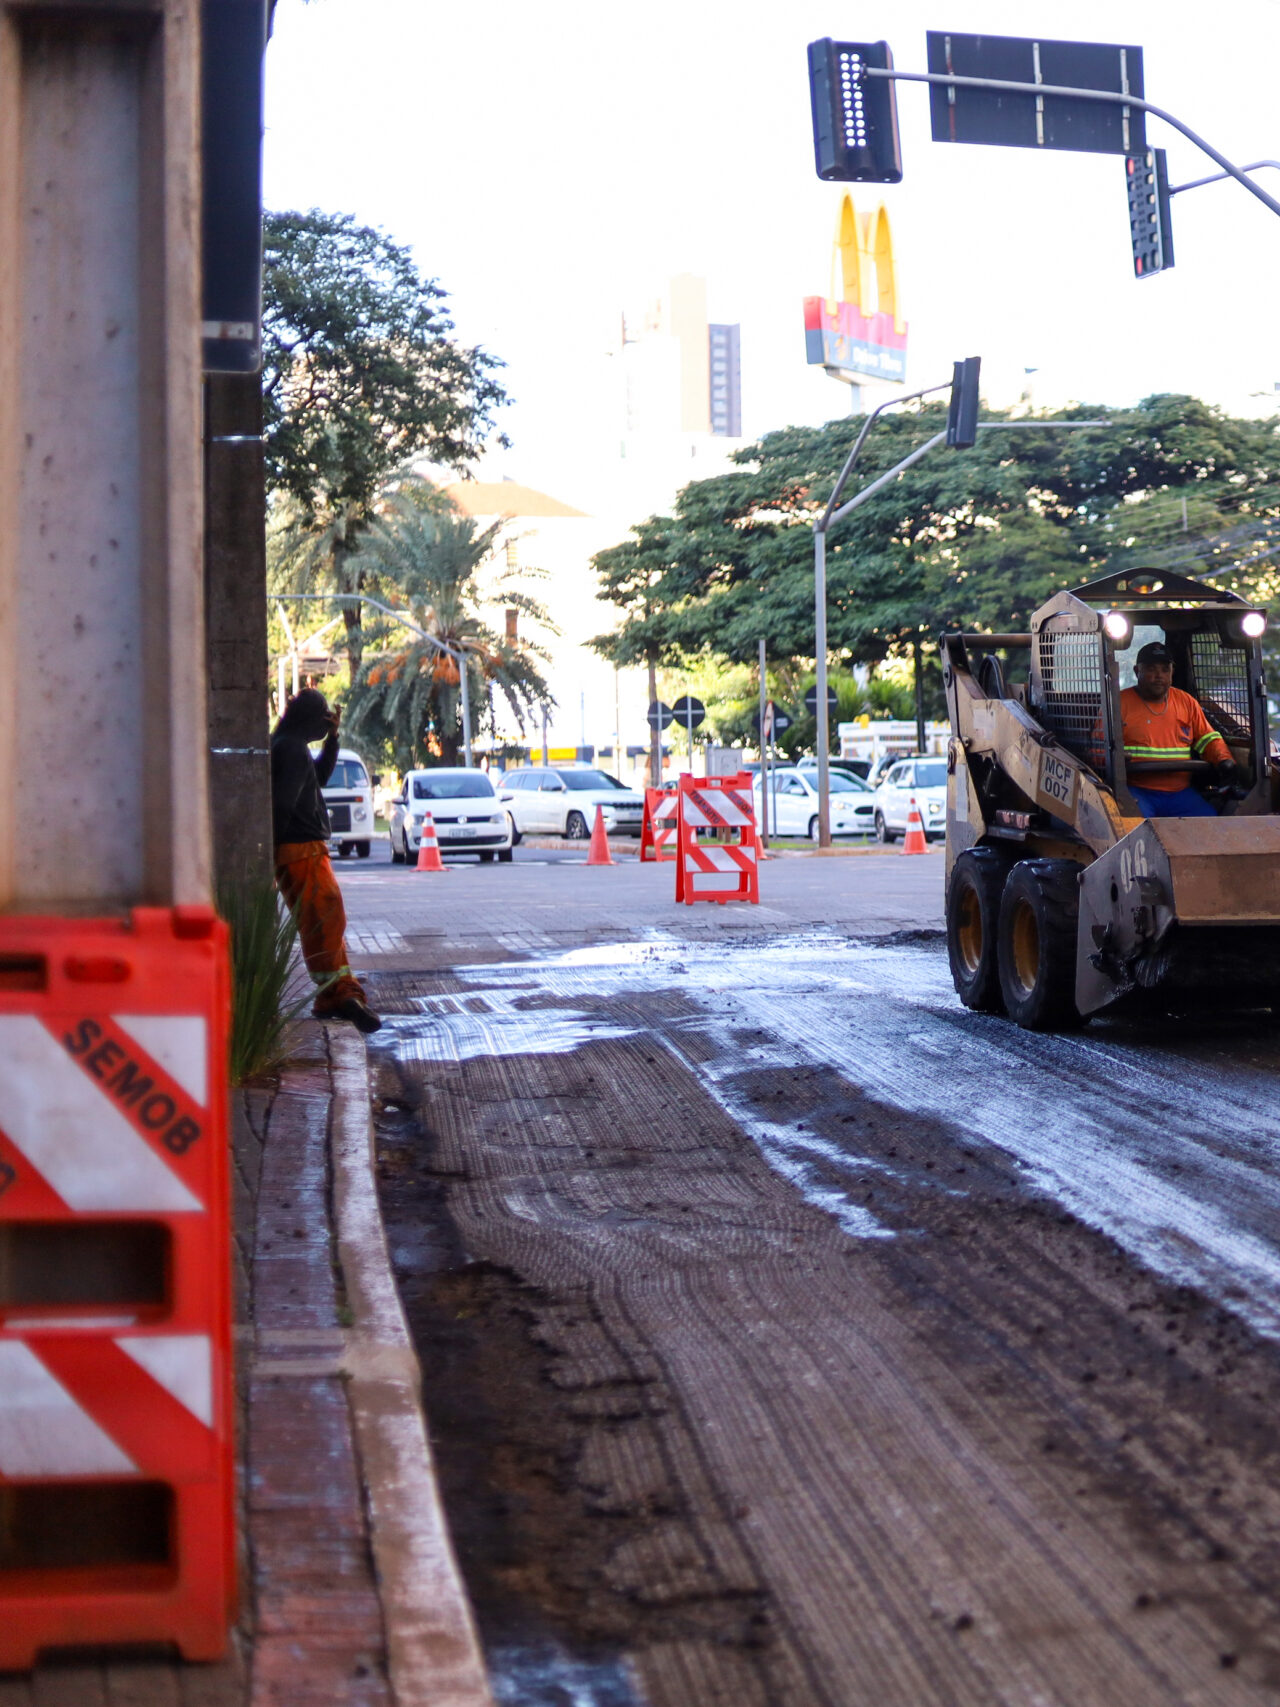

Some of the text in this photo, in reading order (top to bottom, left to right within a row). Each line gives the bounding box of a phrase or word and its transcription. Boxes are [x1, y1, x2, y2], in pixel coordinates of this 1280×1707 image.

[1045, 756, 1071, 782] MCF
[1044, 777, 1069, 801] 007
[62, 1018, 201, 1156] SEMOB
